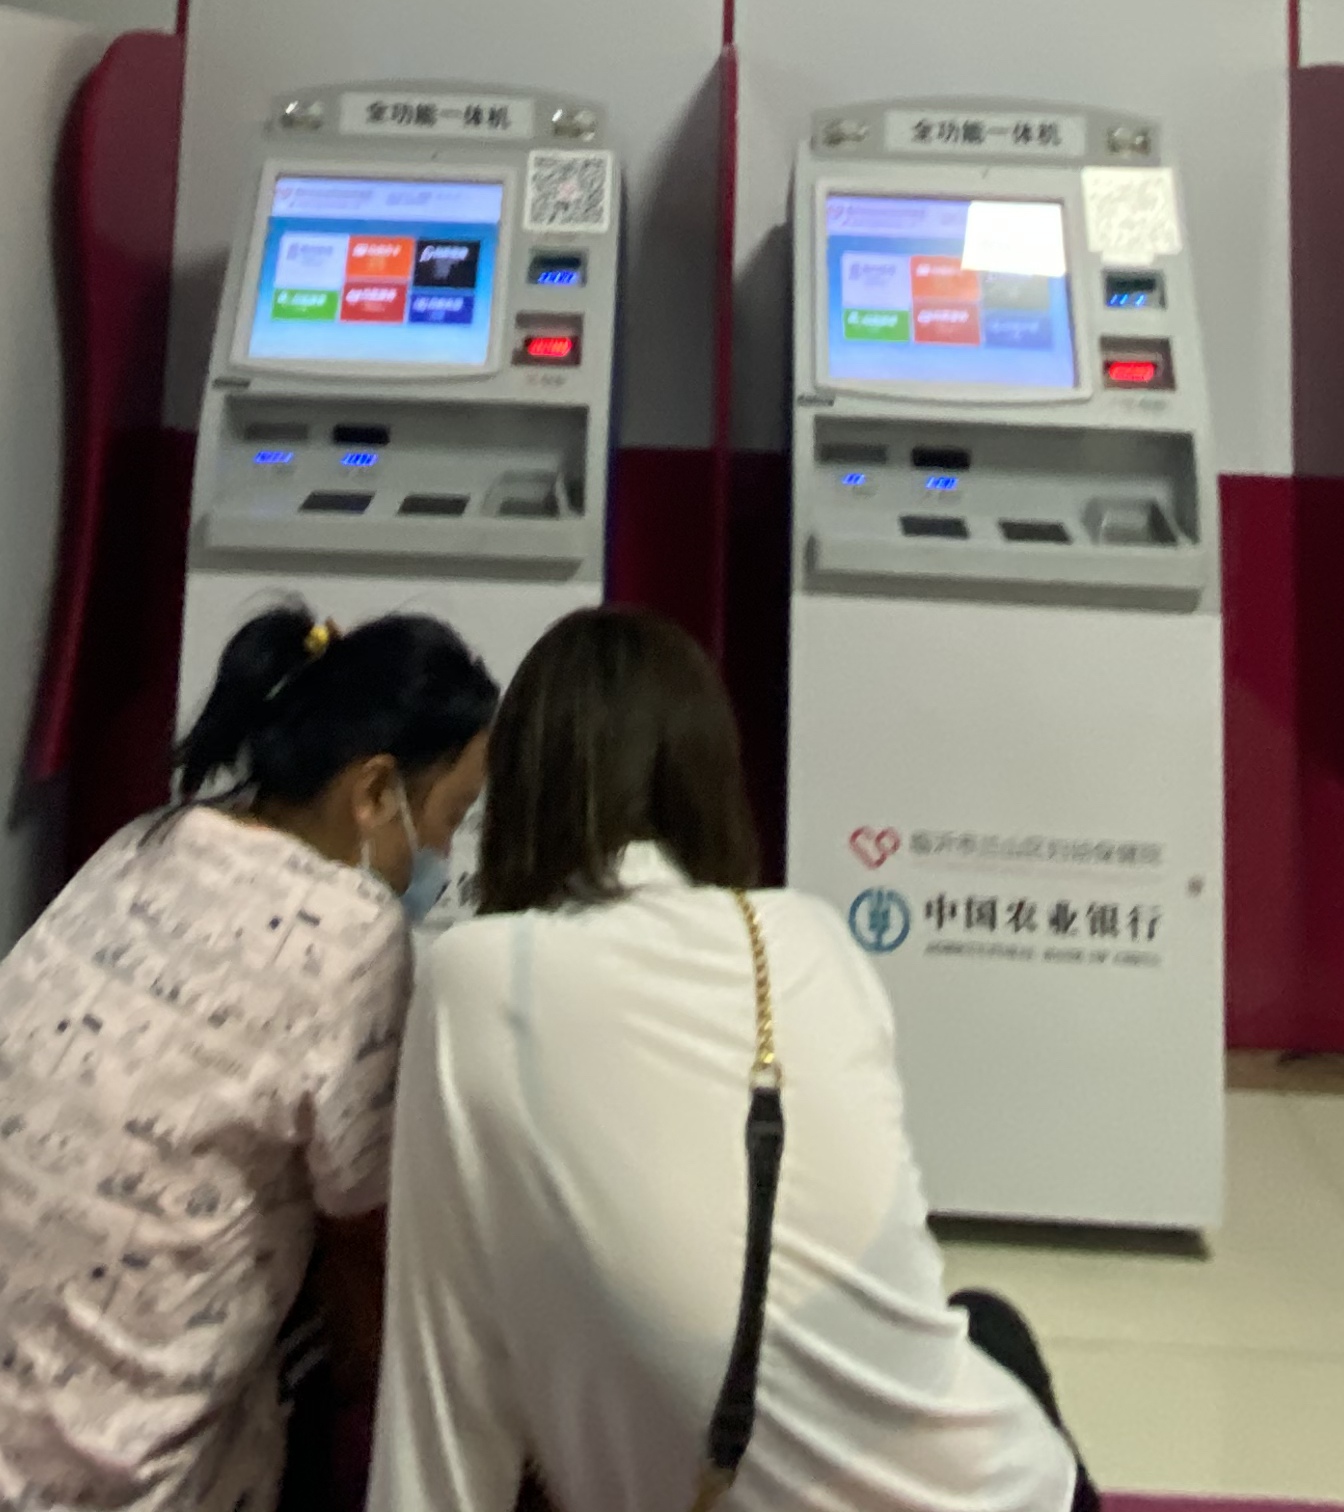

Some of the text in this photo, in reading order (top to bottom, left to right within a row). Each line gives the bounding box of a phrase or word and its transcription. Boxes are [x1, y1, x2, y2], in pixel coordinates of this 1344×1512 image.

[365, 99, 513, 131] 全功能一体机
[910, 118, 1064, 148] 全功能一体机
[925, 890, 1162, 942] 中国农业银行
